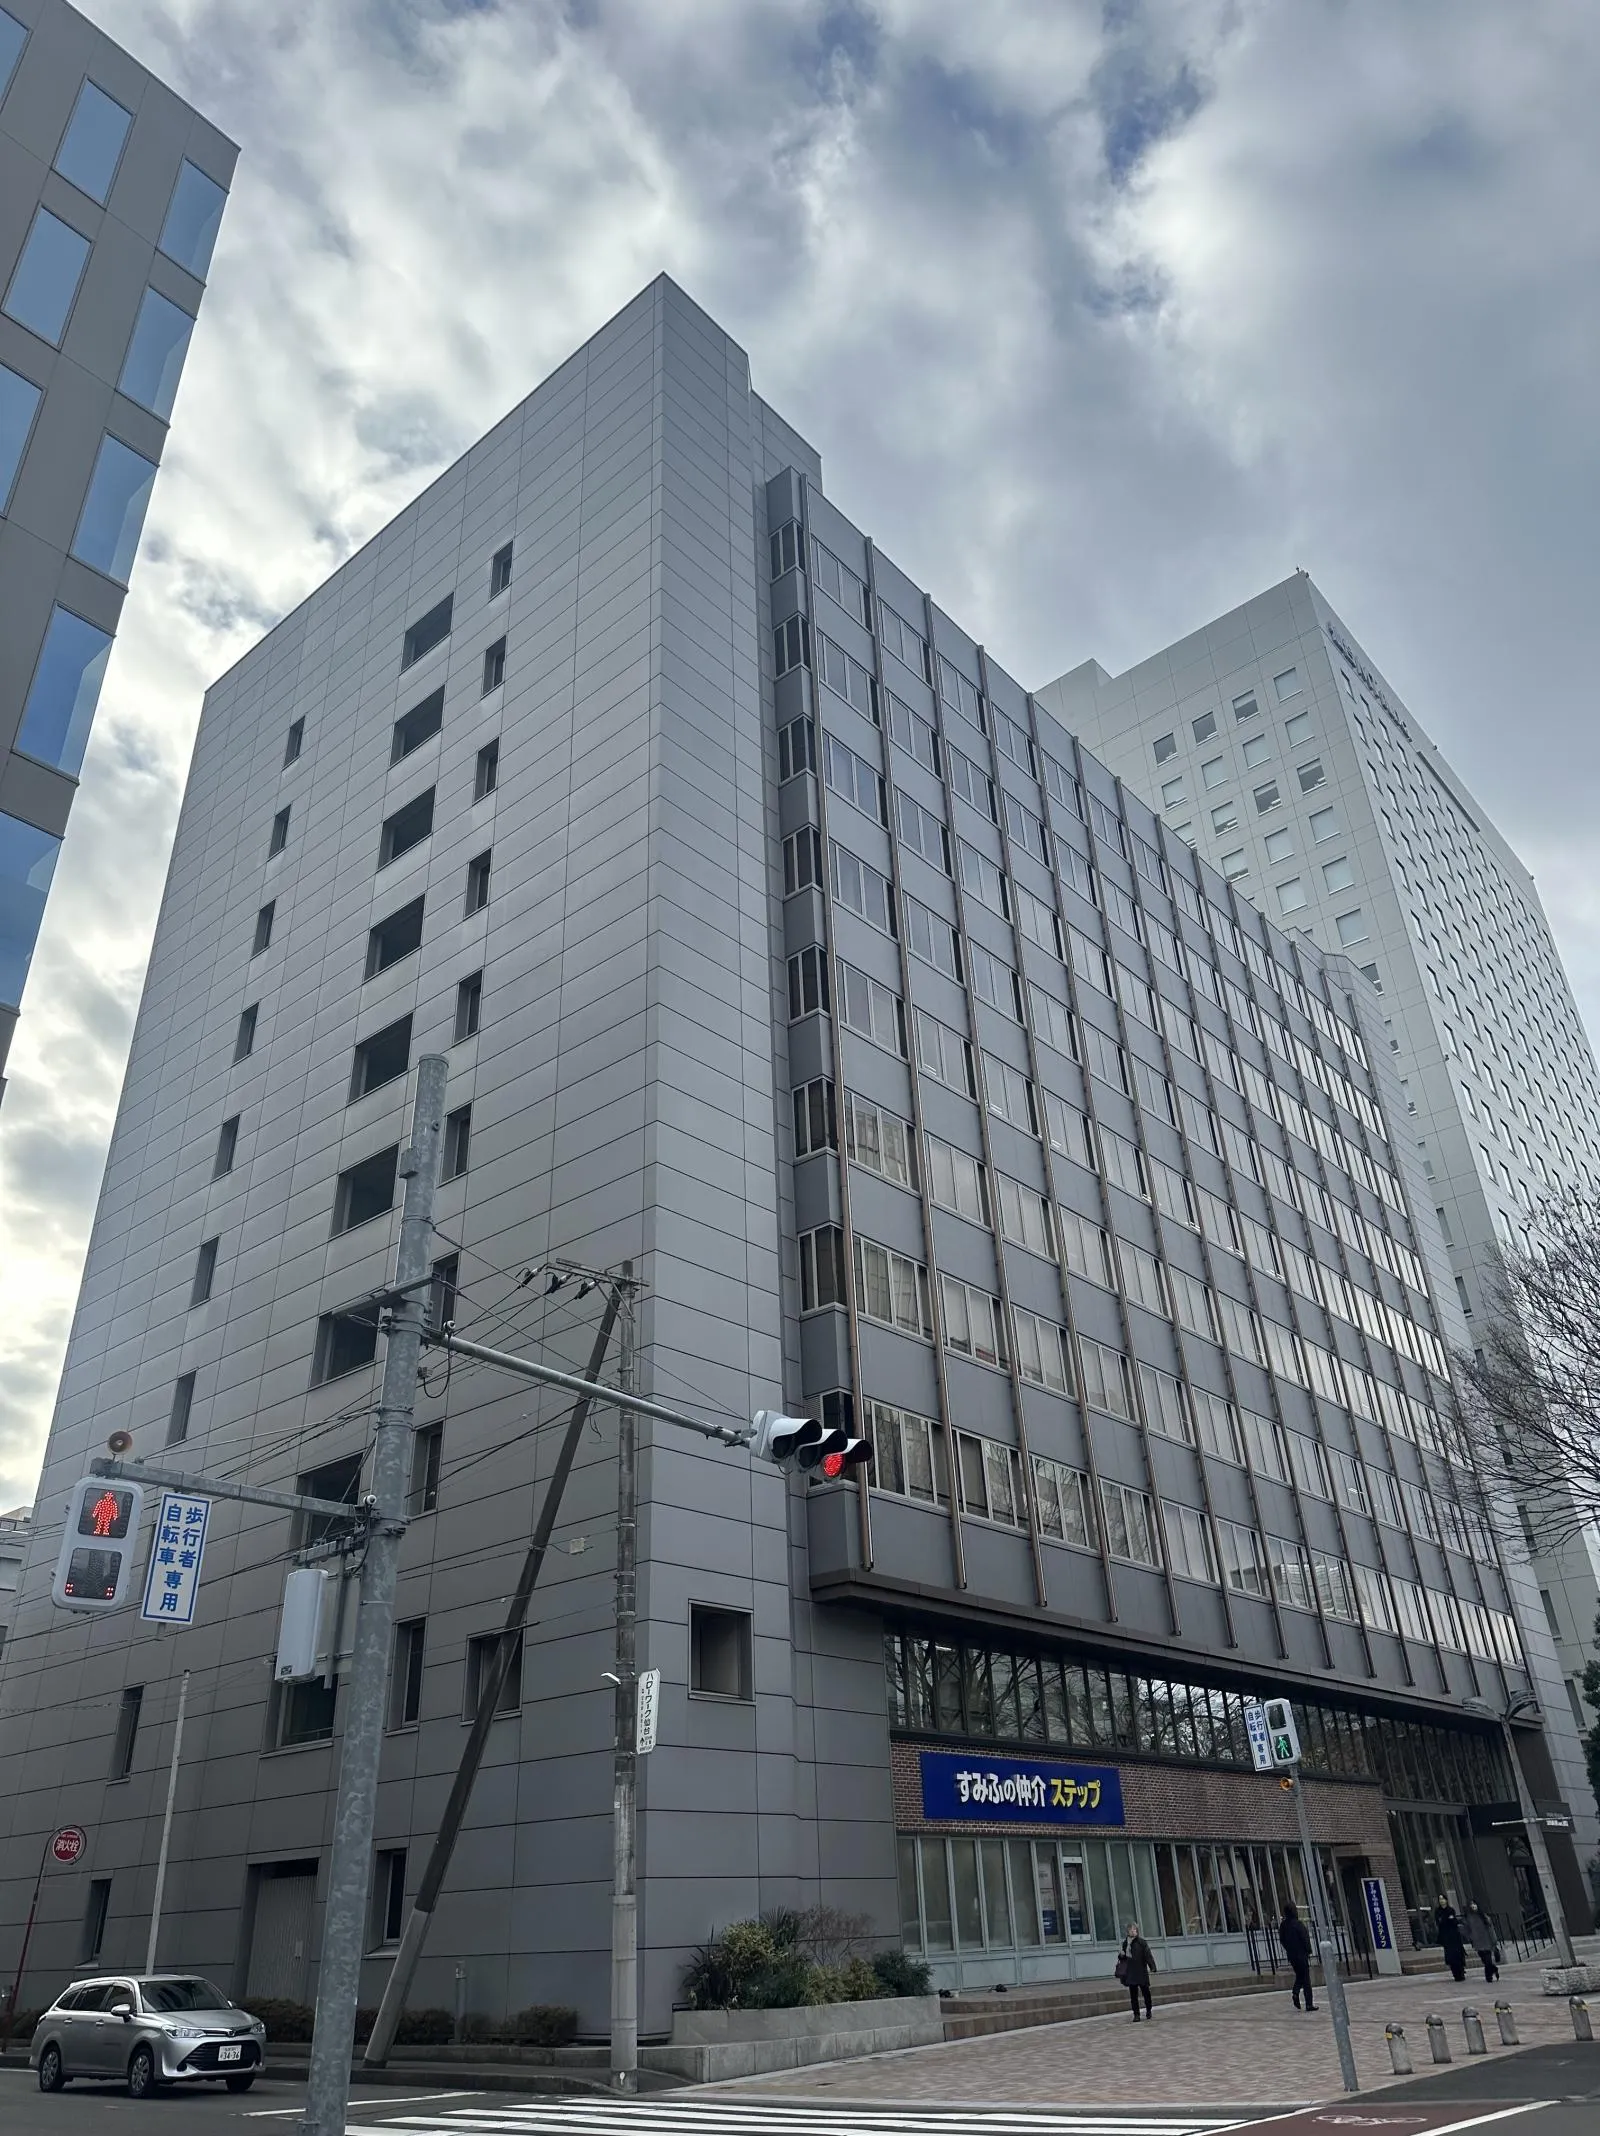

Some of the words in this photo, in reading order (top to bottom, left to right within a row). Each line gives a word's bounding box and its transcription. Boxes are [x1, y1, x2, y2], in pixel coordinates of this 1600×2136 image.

[157, 1504, 182, 1565] 自転車
[179, 1506, 203, 1568] 歩行者
[160, 1570, 183, 1612] 専用
[643, 1673, 654, 1735] ハローワーク仙台
[956, 1770, 1047, 1808] すみふの仲介
[1050, 1779, 1101, 1809] ステップ
[55, 1839, 80, 1852] 消火栓
